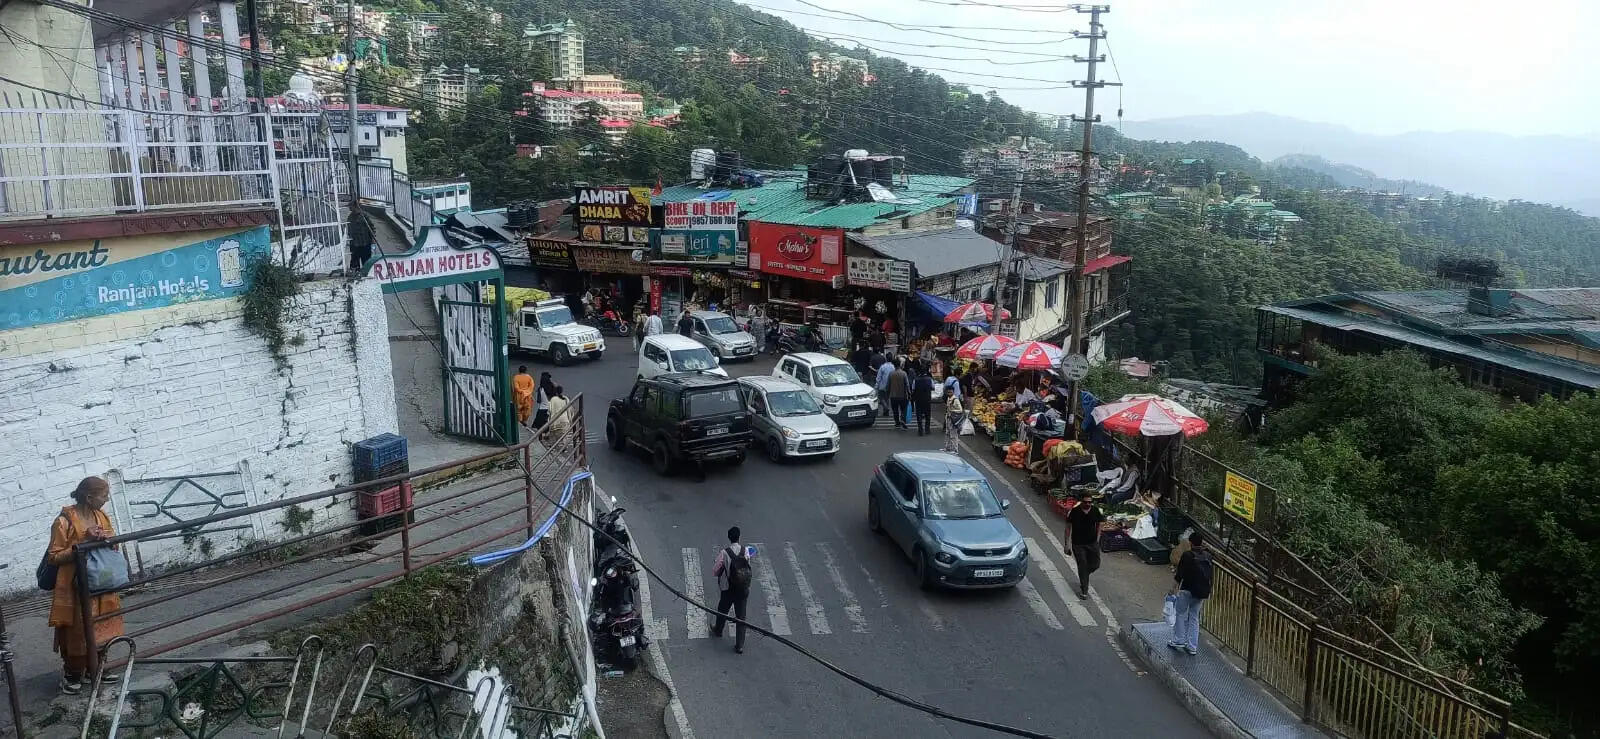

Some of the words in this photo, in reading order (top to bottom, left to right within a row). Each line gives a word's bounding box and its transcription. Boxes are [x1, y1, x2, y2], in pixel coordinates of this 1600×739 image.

[579, 190, 629, 205] AMRIT
[580, 205, 622, 219] DHABA
[666, 203, 689, 216] BIKE
[692, 203, 706, 216] ON
[711, 202, 736, 216] RENT
[666, 216, 689, 226] SCOOTY
[529, 240, 568, 252] BHOJAN
[373, 257, 435, 280] RANJAN
[438, 251, 491, 273] HOTELS
[98, 283, 157, 306] Ranjan
[159, 276, 210, 298] Hotels
